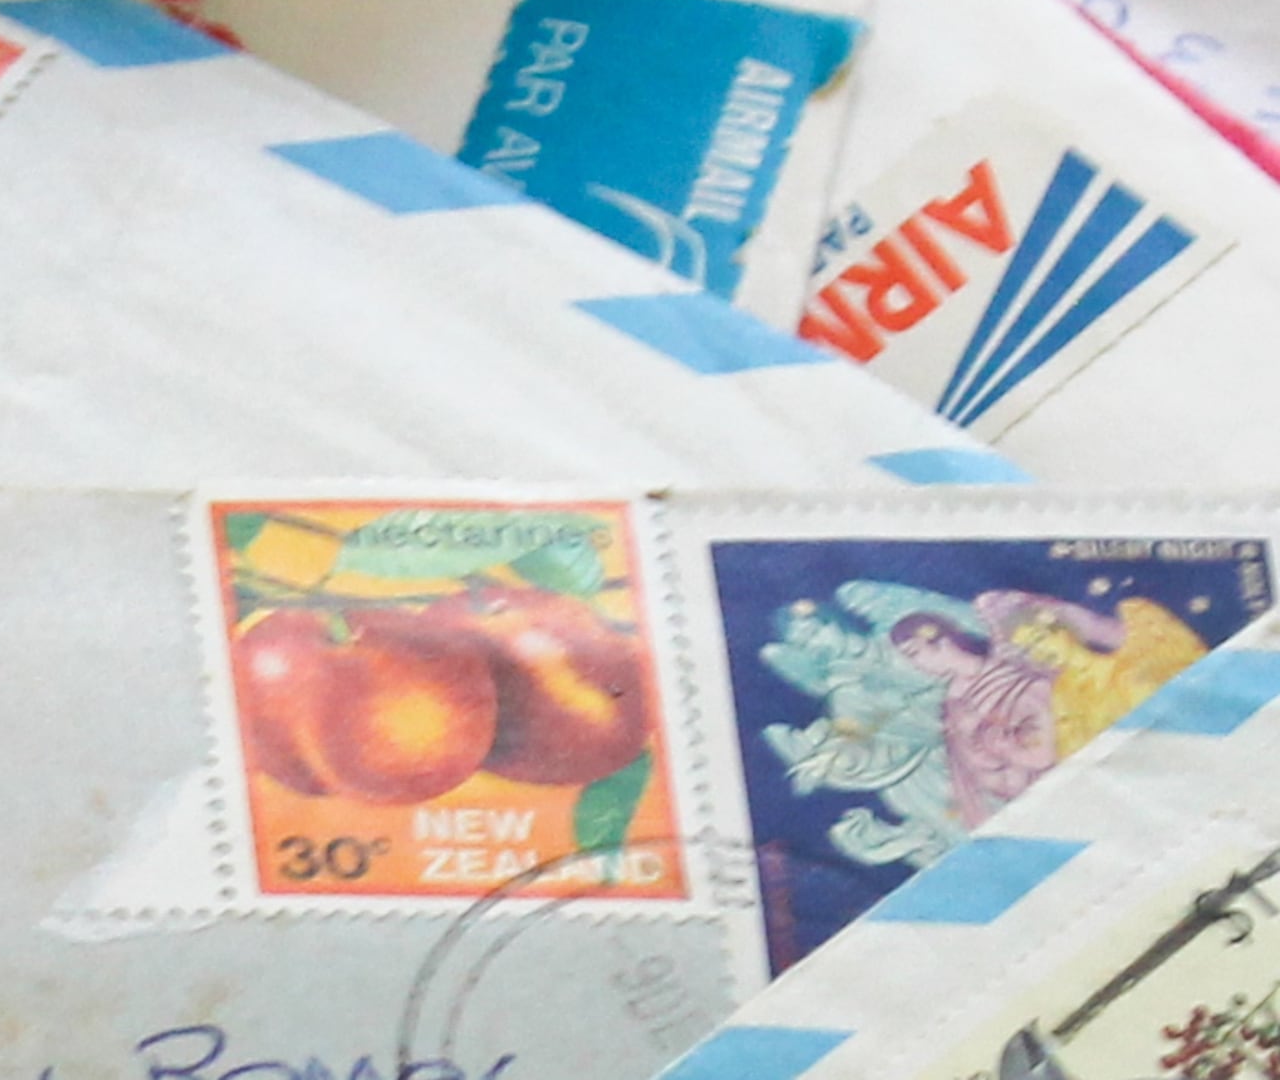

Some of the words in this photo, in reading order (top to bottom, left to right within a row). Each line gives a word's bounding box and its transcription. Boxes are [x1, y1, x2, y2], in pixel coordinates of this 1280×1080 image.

[502, 16, 591, 118] PAR
[682, 56, 794, 224] AIRMAIL
[344, 514, 614, 554] nectarines
[412, 806, 535, 842] NEW
[418, 848, 666, 885] ZEALAND
